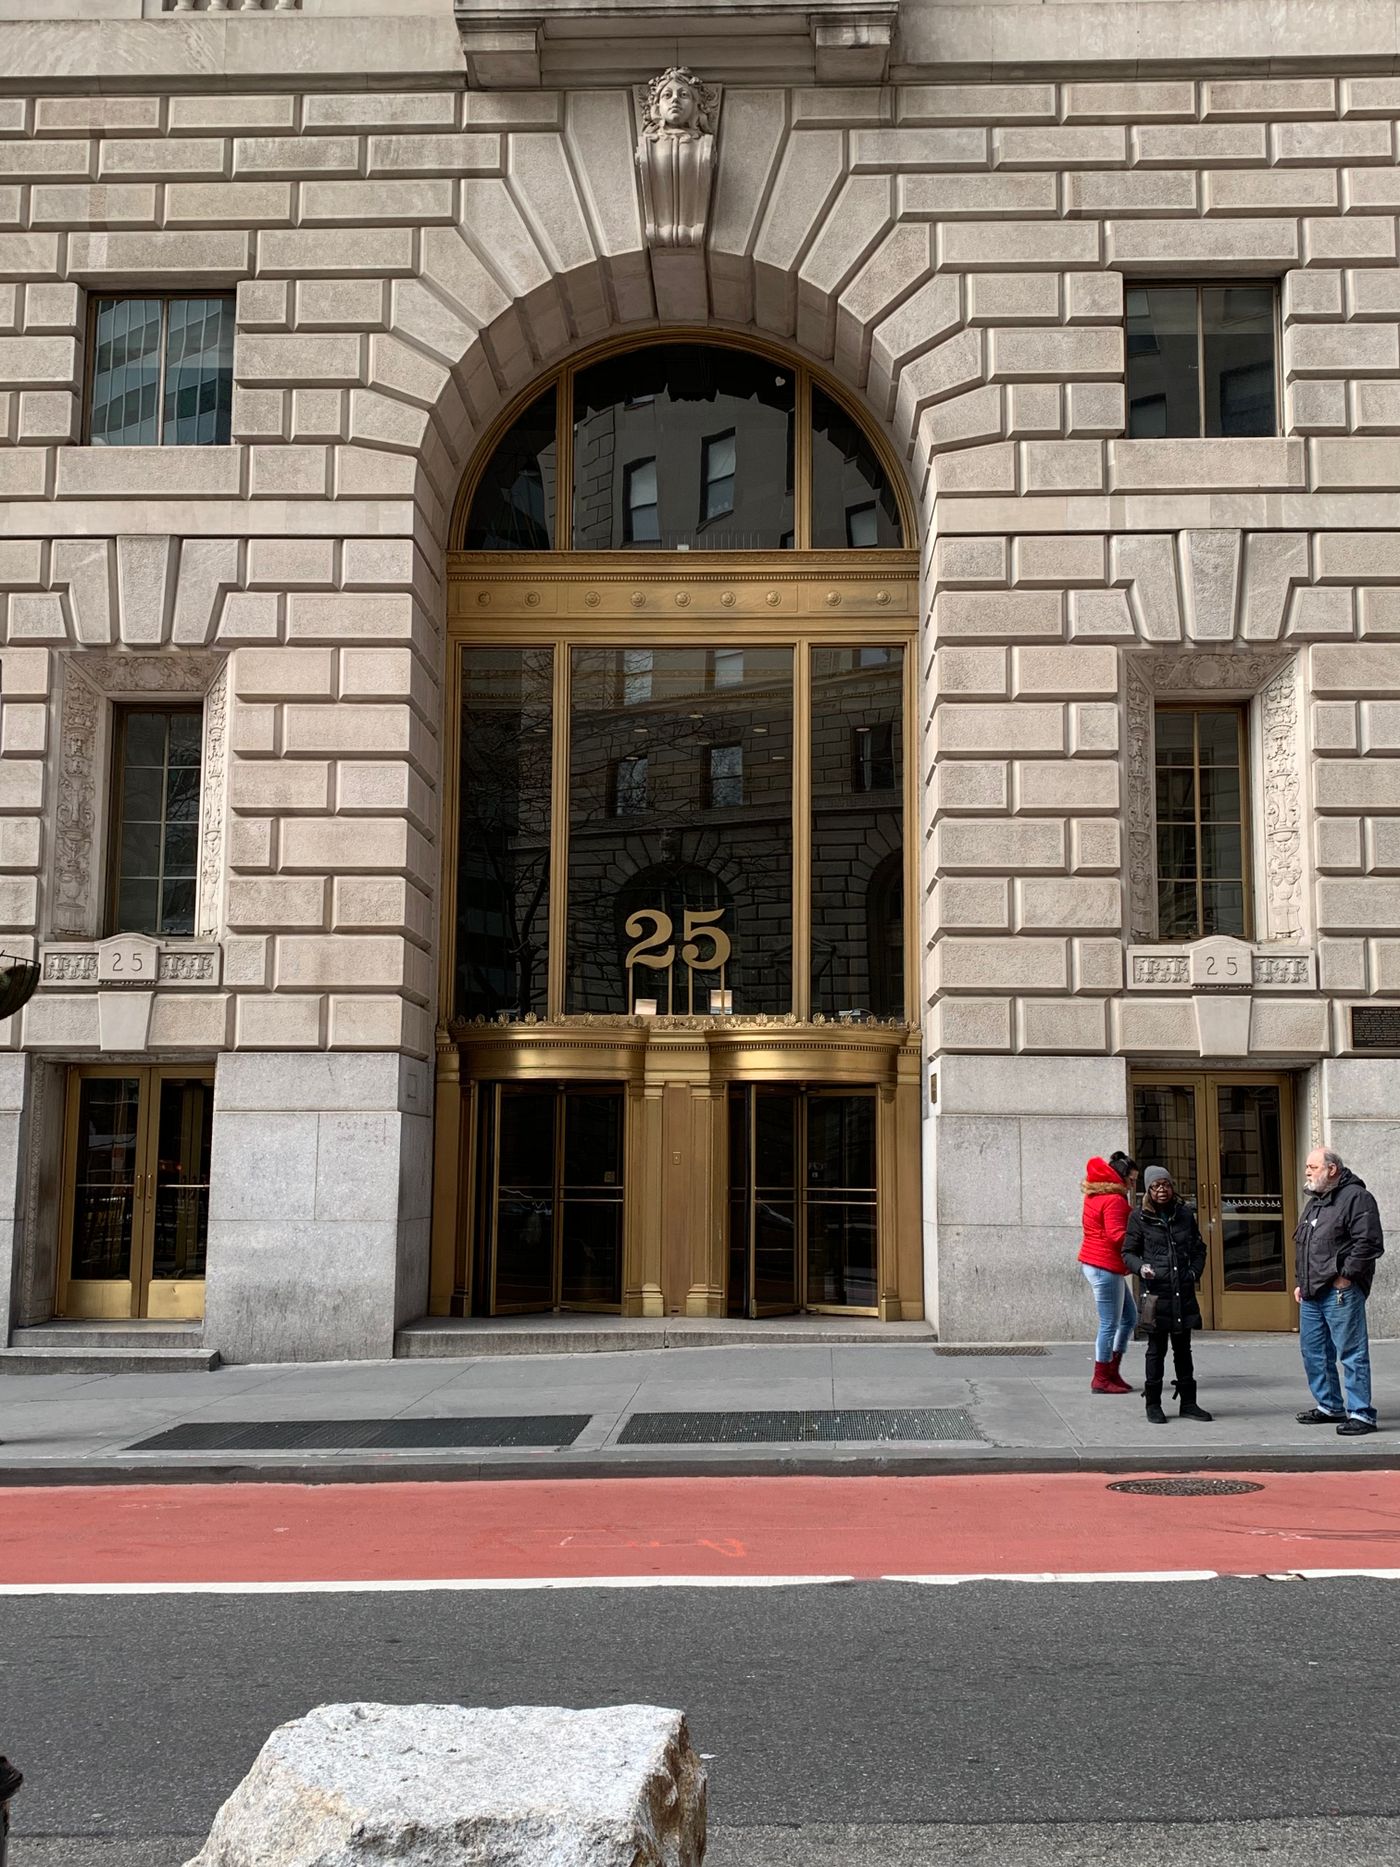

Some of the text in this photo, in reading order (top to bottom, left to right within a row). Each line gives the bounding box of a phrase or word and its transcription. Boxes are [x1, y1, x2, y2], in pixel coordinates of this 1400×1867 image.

[625, 908, 731, 970] 25
[112, 952, 143, 972] 25
[1206, 956, 1238, 976] 25
